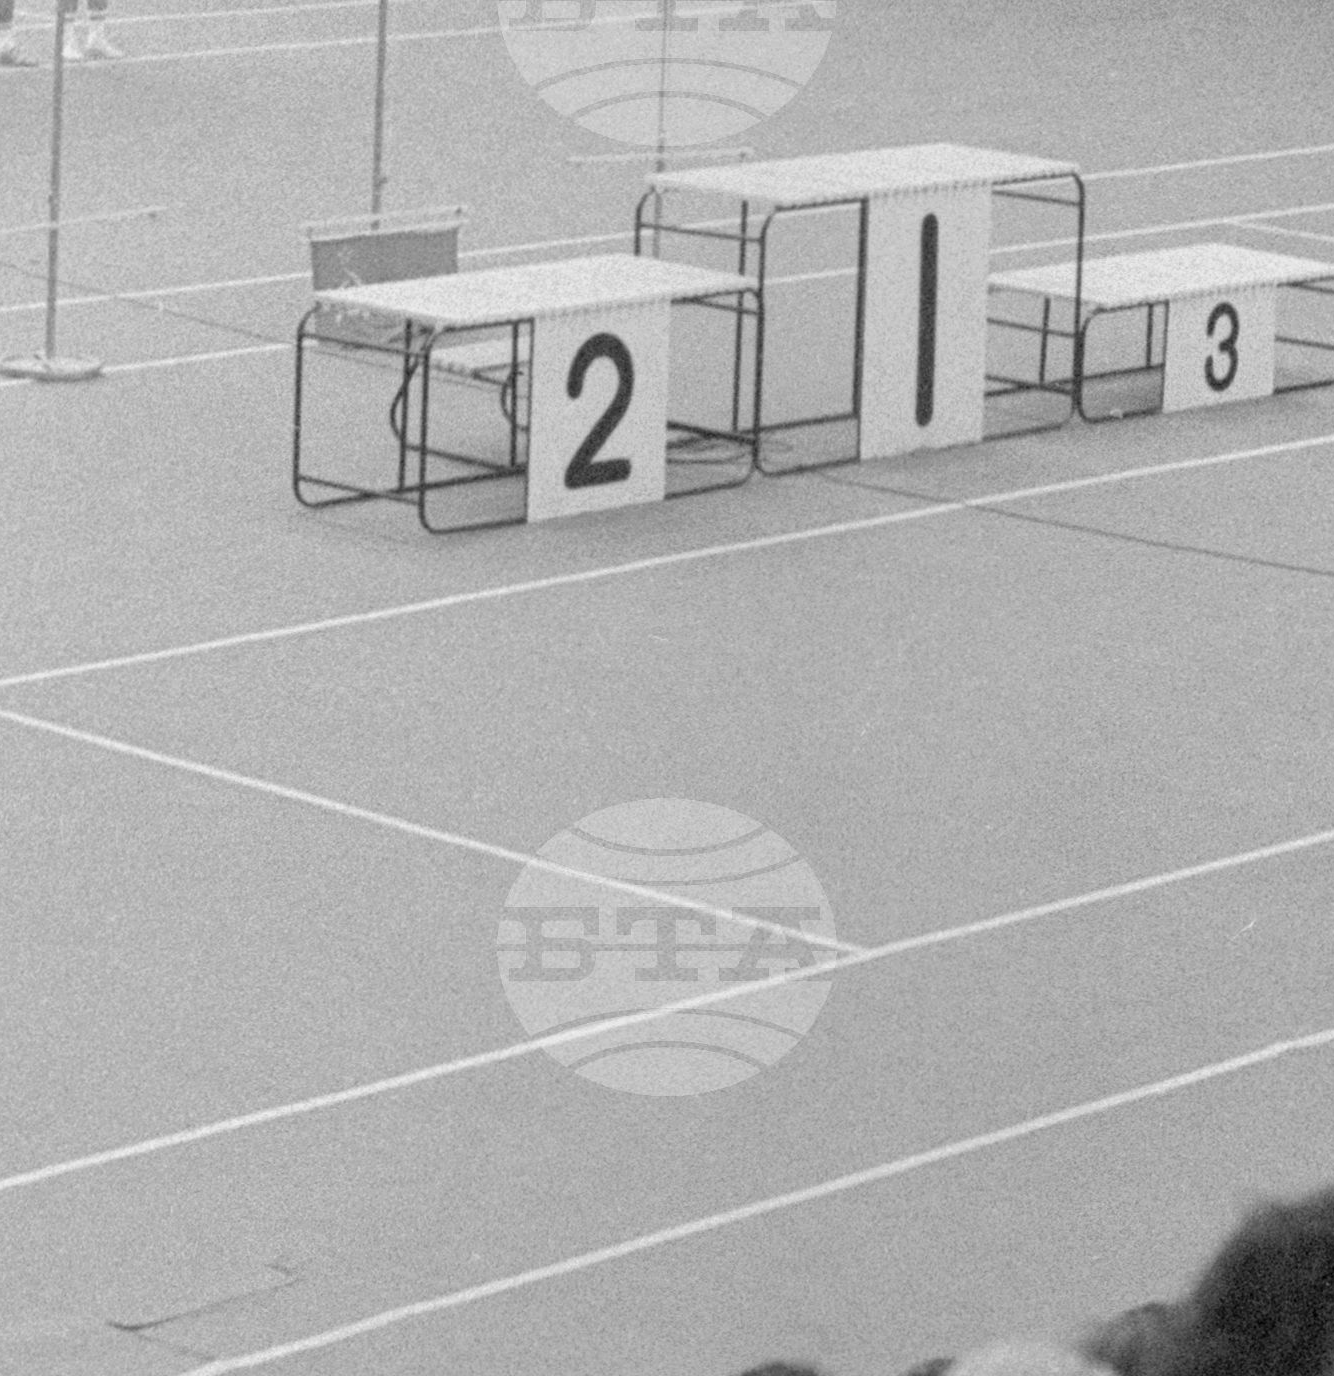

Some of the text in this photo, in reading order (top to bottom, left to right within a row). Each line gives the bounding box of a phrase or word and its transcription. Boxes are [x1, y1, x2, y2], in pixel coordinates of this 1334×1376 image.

[915, 213, 939, 427] 1
[1204, 302, 1240, 392] 3
[564, 332, 635, 490] 2
